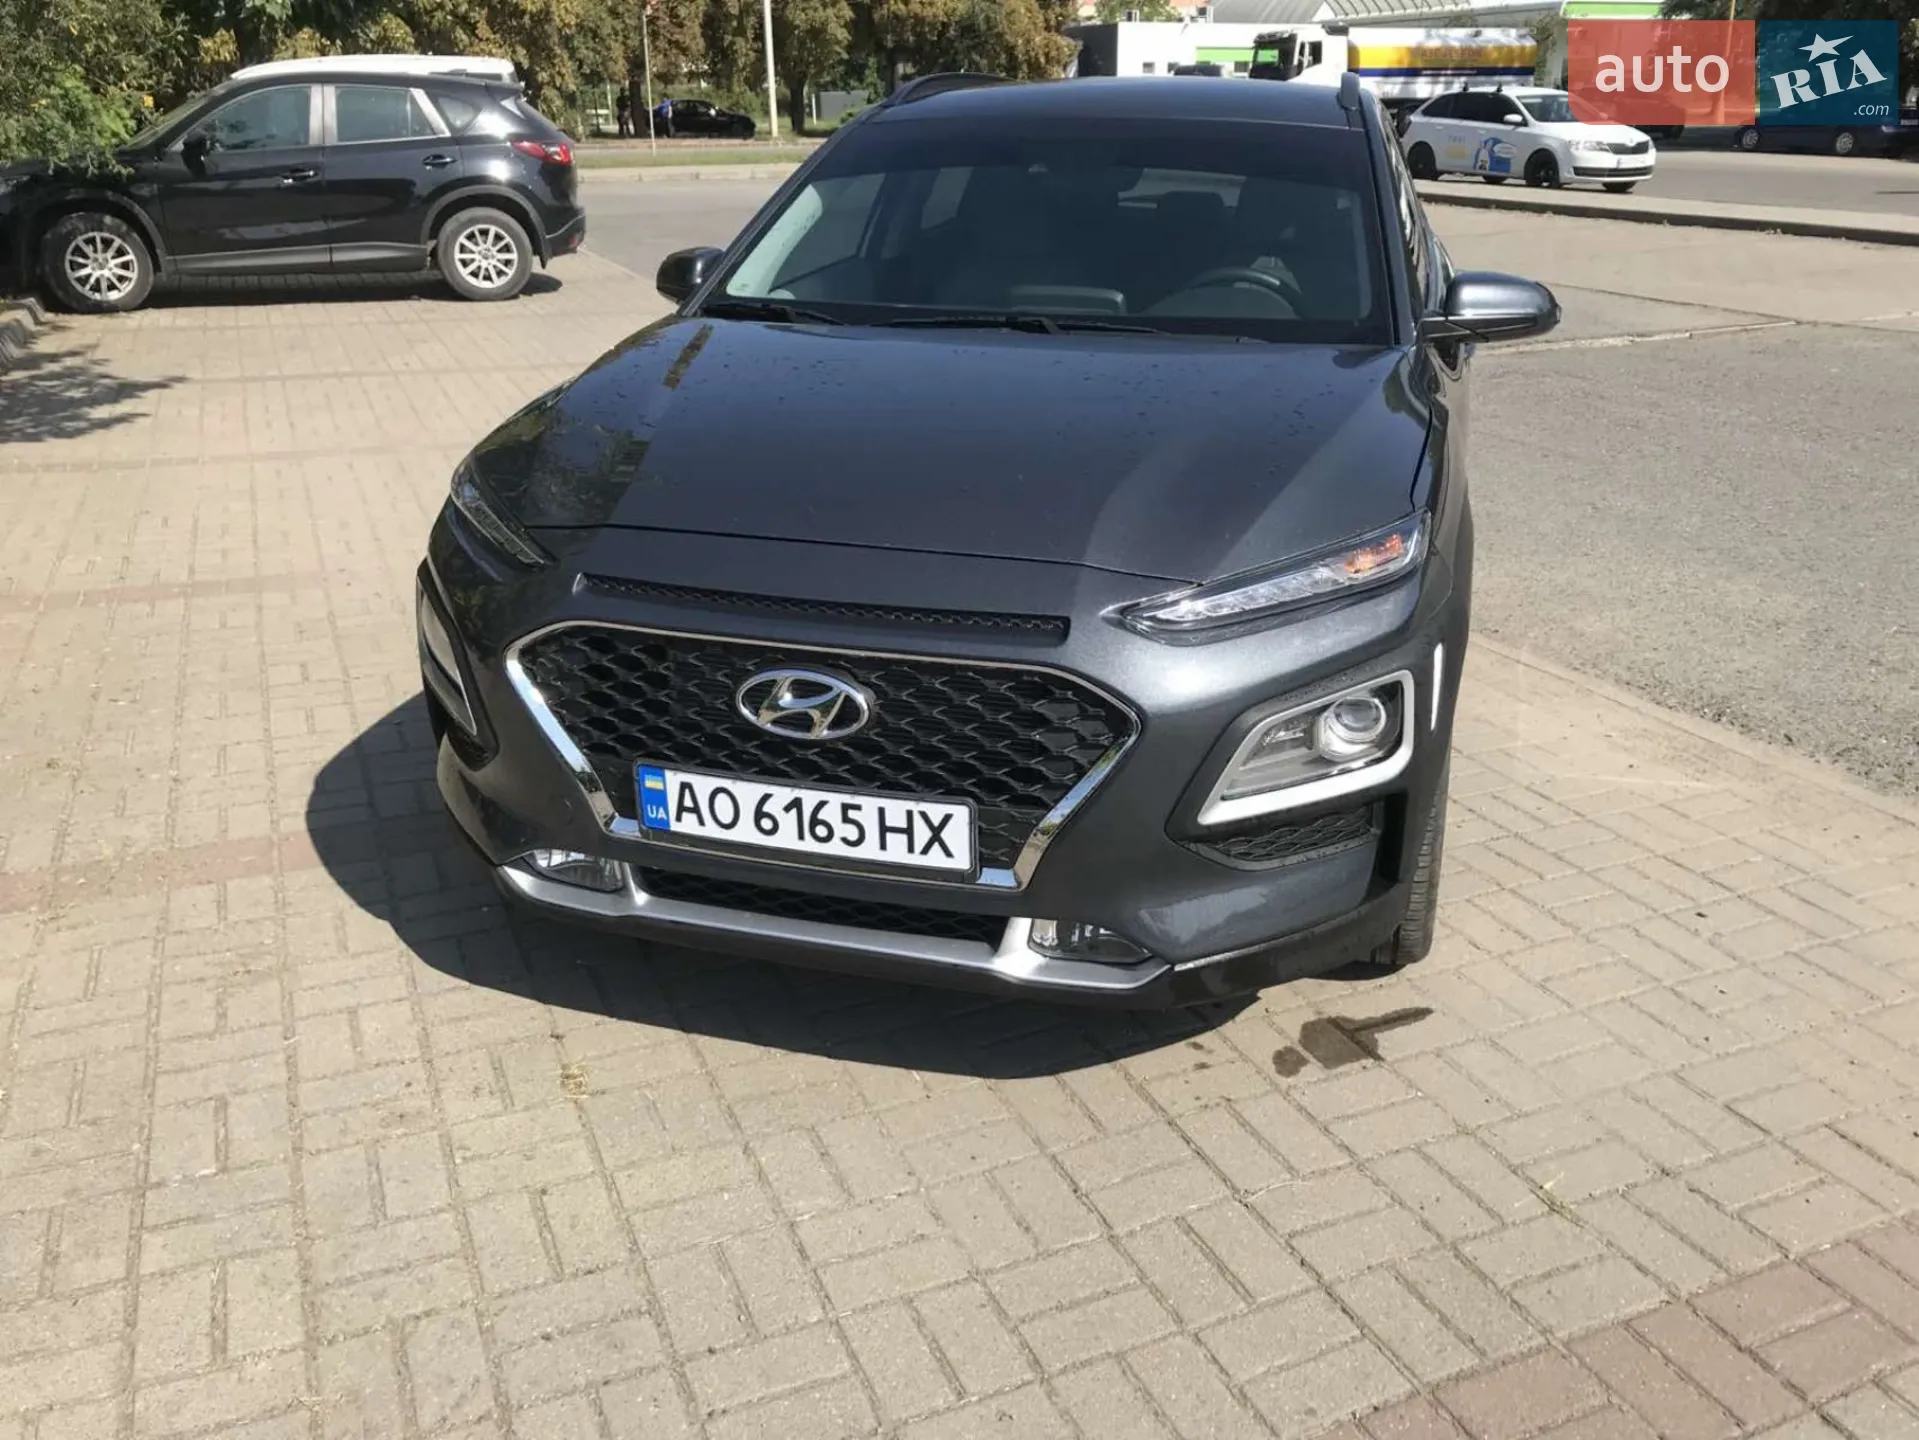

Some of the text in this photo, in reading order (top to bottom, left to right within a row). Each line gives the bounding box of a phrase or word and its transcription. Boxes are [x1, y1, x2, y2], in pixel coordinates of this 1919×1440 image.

[647, 803, 668, 821] UA
[675, 781, 955, 859] AO 6165 HX
